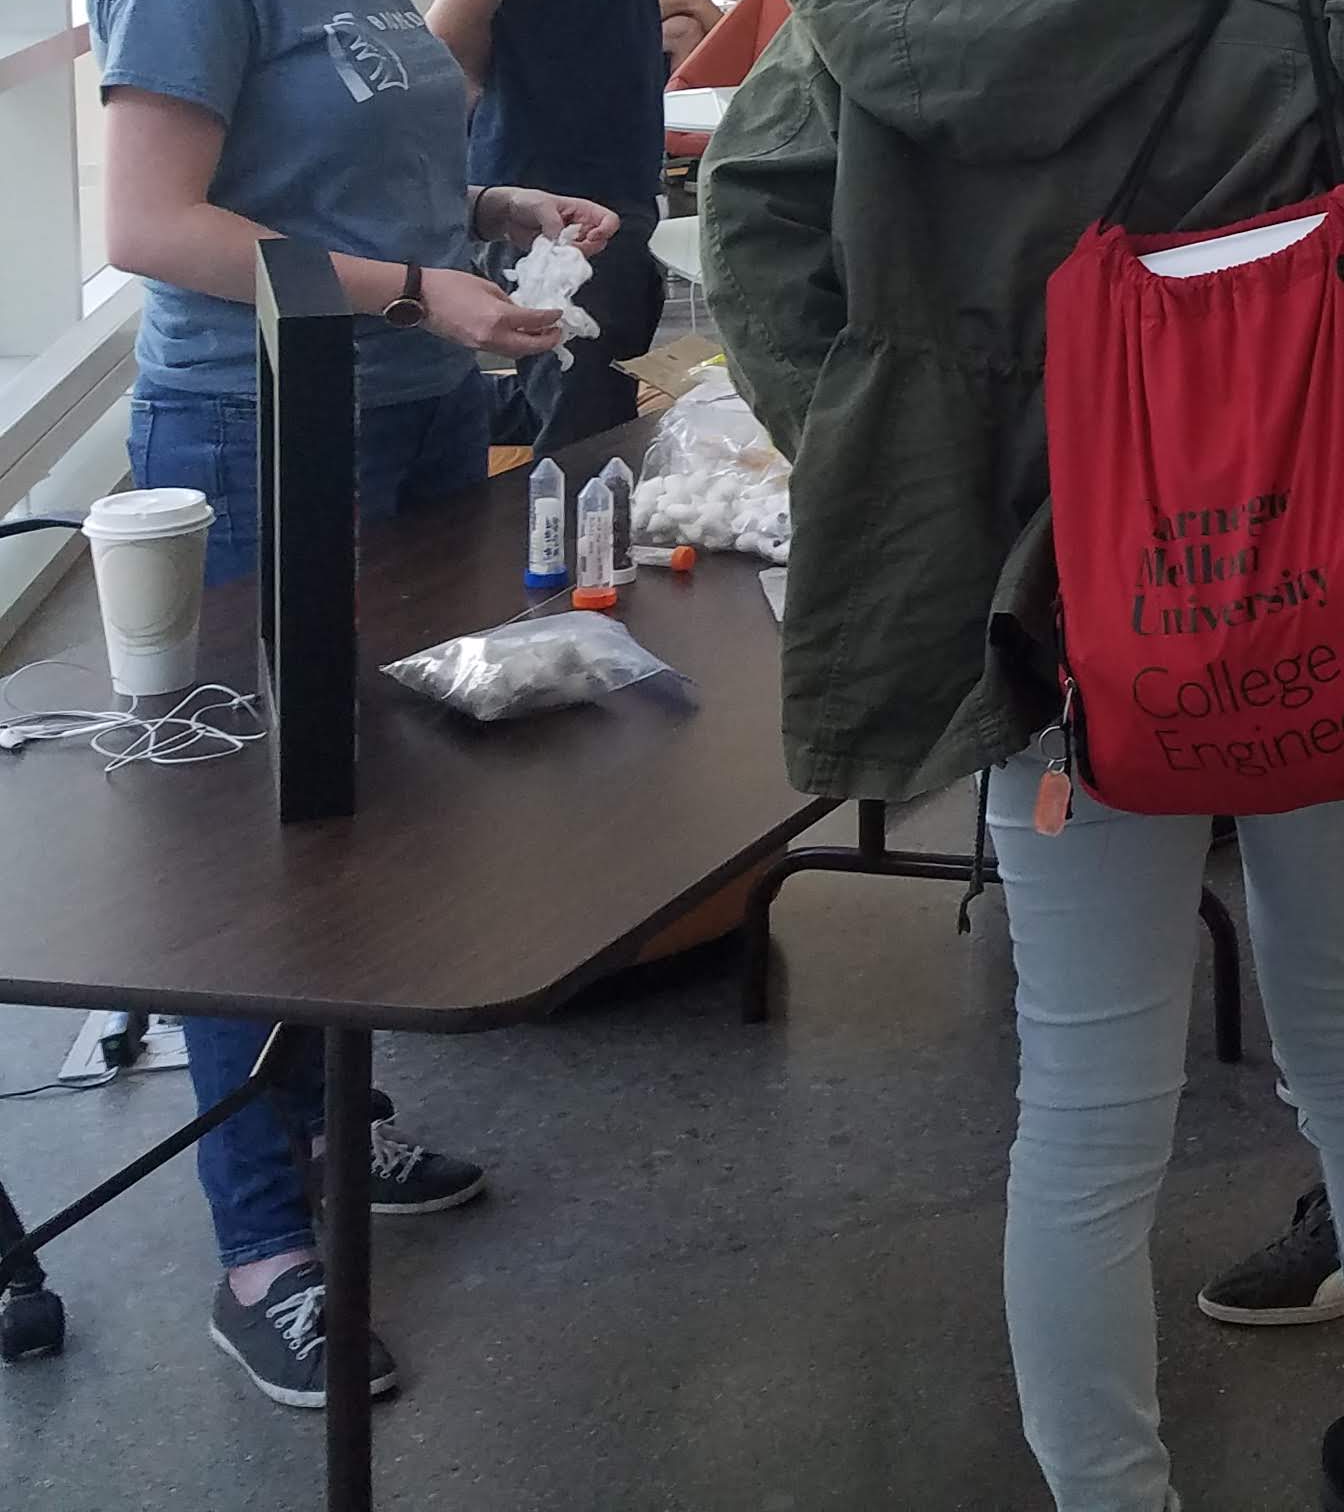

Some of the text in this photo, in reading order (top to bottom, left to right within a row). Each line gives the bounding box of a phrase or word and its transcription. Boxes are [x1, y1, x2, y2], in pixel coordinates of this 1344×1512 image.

[1137, 542, 1261, 589] Mellon
[1131, 567, 1329, 637] University
[1132, 644, 1341, 720] College
